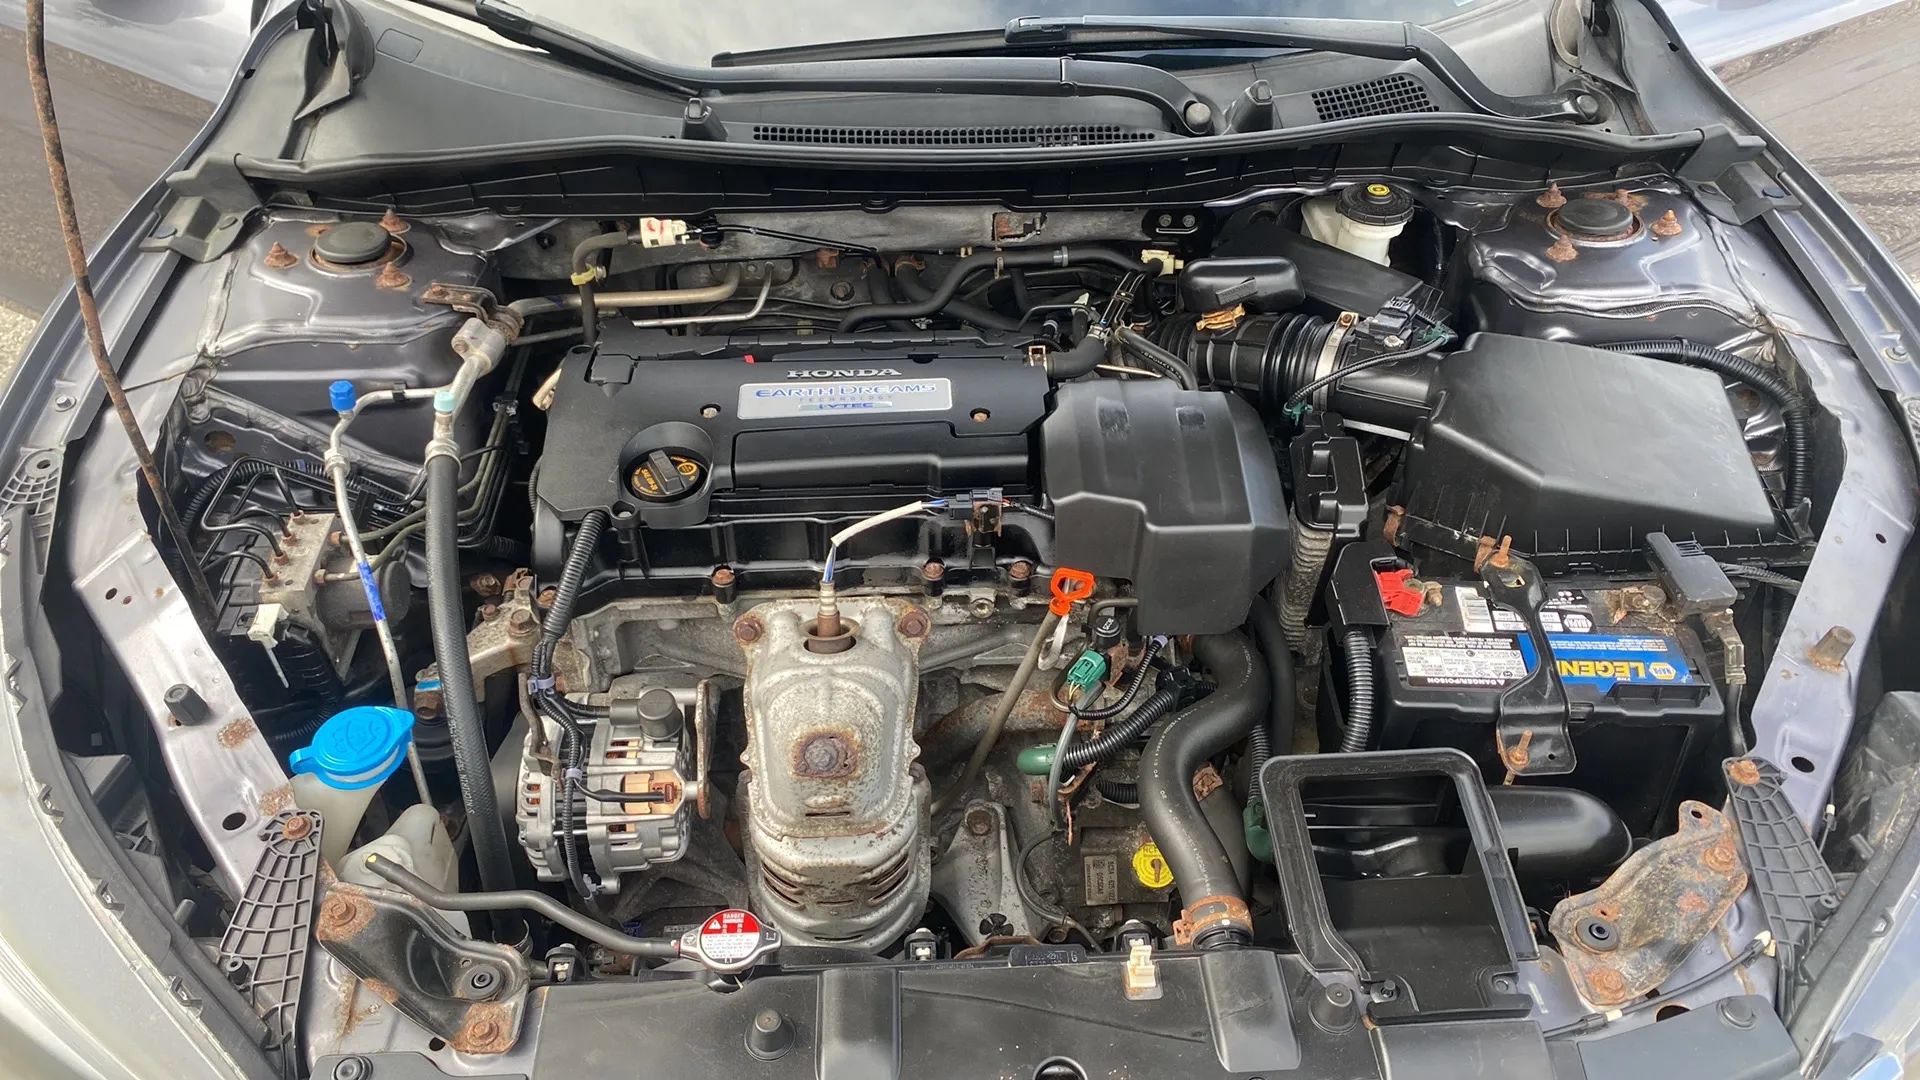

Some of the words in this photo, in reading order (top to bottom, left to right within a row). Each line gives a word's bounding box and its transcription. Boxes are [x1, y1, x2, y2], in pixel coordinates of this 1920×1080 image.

[787, 368, 902, 379] HONDA
[755, 388, 833, 398] EARTH
[840, 384, 936, 395] DREAMS
[1556, 660, 1645, 678] LEGEN
